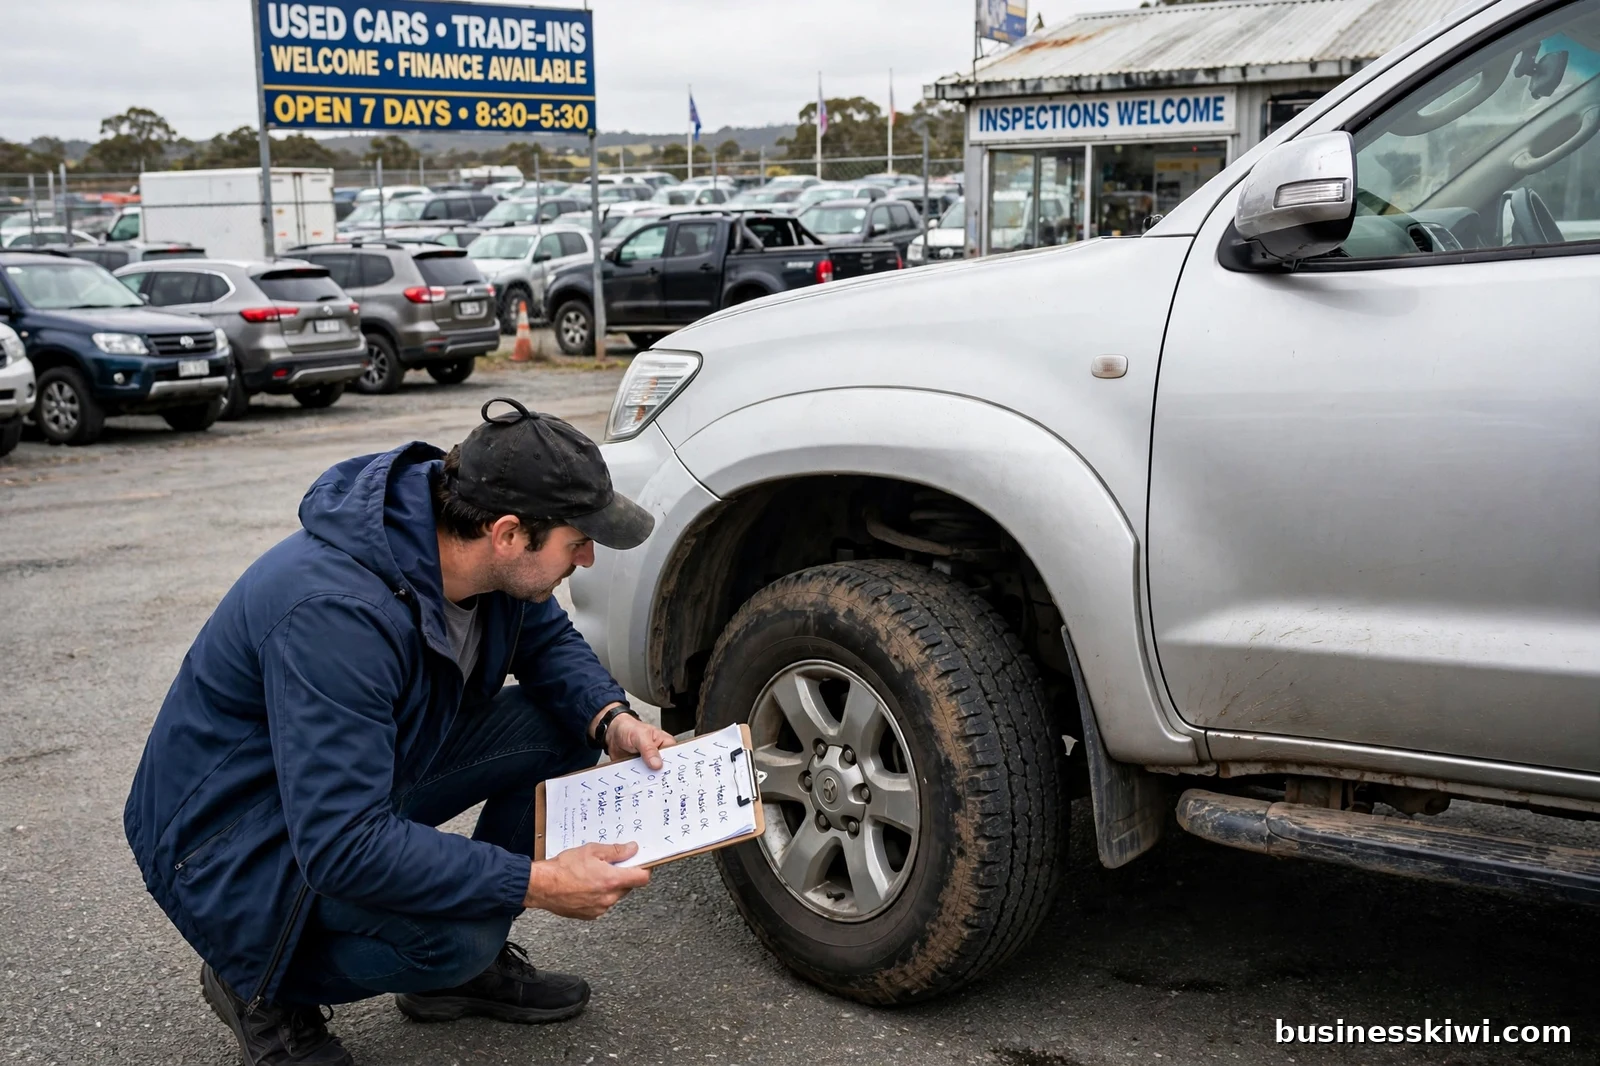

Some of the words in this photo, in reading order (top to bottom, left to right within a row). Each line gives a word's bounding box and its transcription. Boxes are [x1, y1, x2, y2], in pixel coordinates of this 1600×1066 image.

[268, 3, 346, 40] USED
[354, 8, 428, 45] CARS
[452, 15, 585, 53] TRADE-INS
[271, 45, 379, 75] WELCOME
[398, 52, 484, 80] FINANCE
[488, 56, 586, 84] AVAILABLE
[274, 95, 352, 124] OPEN
[360, 98, 375, 123] 7
[384, 99, 451, 125] DAYS
[475, 101, 588, 129] 8:30–5:30
[979, 102, 1109, 132] INSPECTIONS
[1116, 96, 1225, 125] WELCOME
[699, 817, 709, 831] OK
[717, 810, 728, 823] OK
[632, 818, 642, 832] OK
[680, 823, 690, 837] OK
[597, 827, 607, 842] OK
